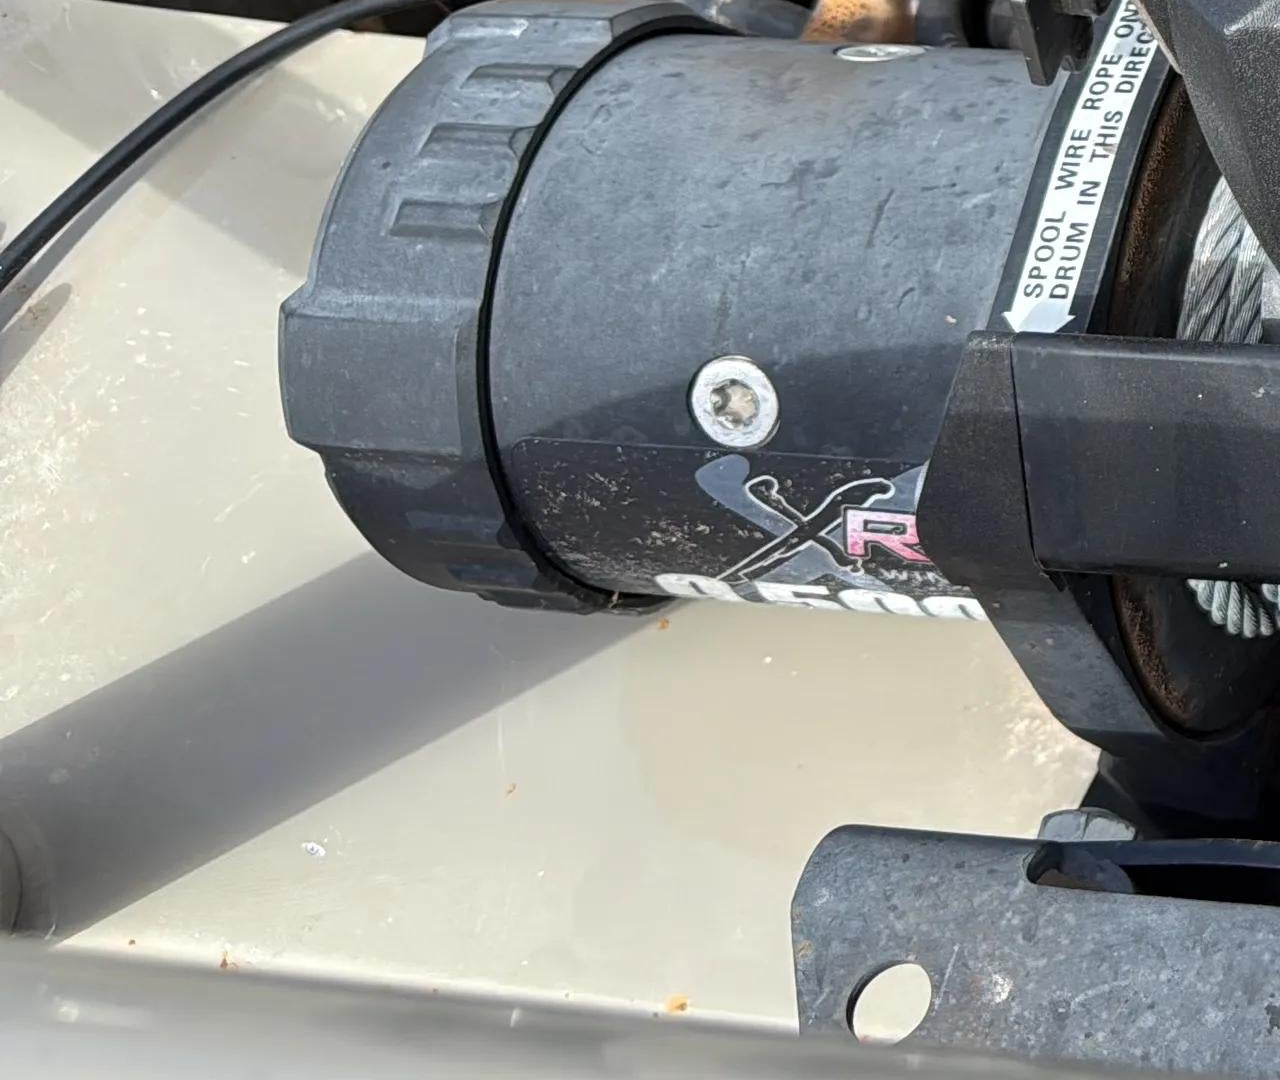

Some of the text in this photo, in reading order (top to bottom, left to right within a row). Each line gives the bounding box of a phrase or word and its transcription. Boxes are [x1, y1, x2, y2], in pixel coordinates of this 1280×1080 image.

[1023, 210, 1067, 299] SPOOL
[1054, 128, 1092, 191] WIRE
[1081, 53, 1122, 111] ROPE
[1049, 28, 1155, 300] DRUM IN THIS DIREC
[716, 474, 933, 584] XR
